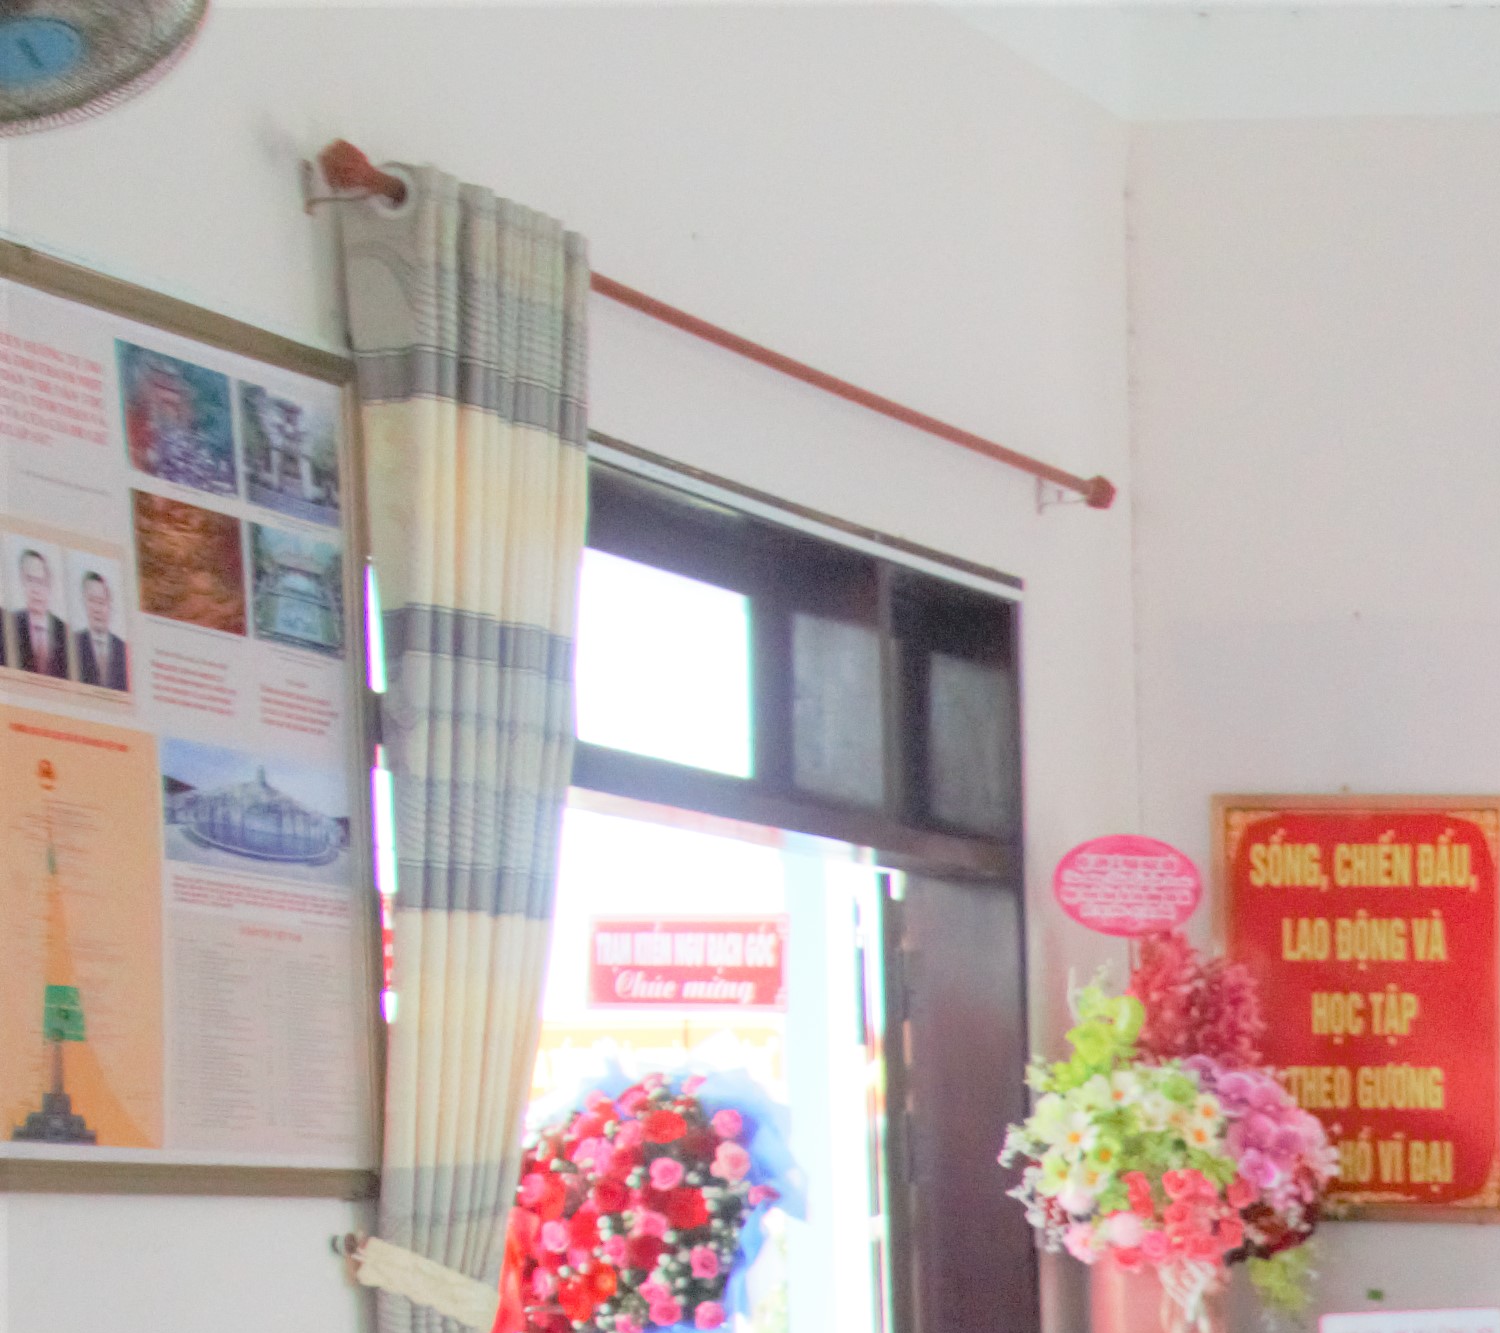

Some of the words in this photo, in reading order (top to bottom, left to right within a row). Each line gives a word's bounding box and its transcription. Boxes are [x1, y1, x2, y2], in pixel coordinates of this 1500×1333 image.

[1250, 828, 1330, 893] SỐNG,
[1334, 829, 1412, 887] CHIẾN
[1417, 828, 1479, 893] ĐẤU,
[1282, 916, 1330, 961] LAO
[1335, 908, 1408, 971] ĐỘNG
[1411, 908, 1448, 962] VÀ
[615, 969, 677, 999] Chúc
[1312, 991, 1365, 1045] HỌC
[1368, 982, 1419, 1046] TẬP
[1356, 1062, 1445, 1111] GƯƠNG
[1409, 1139, 1453, 1194] ĐẠI
